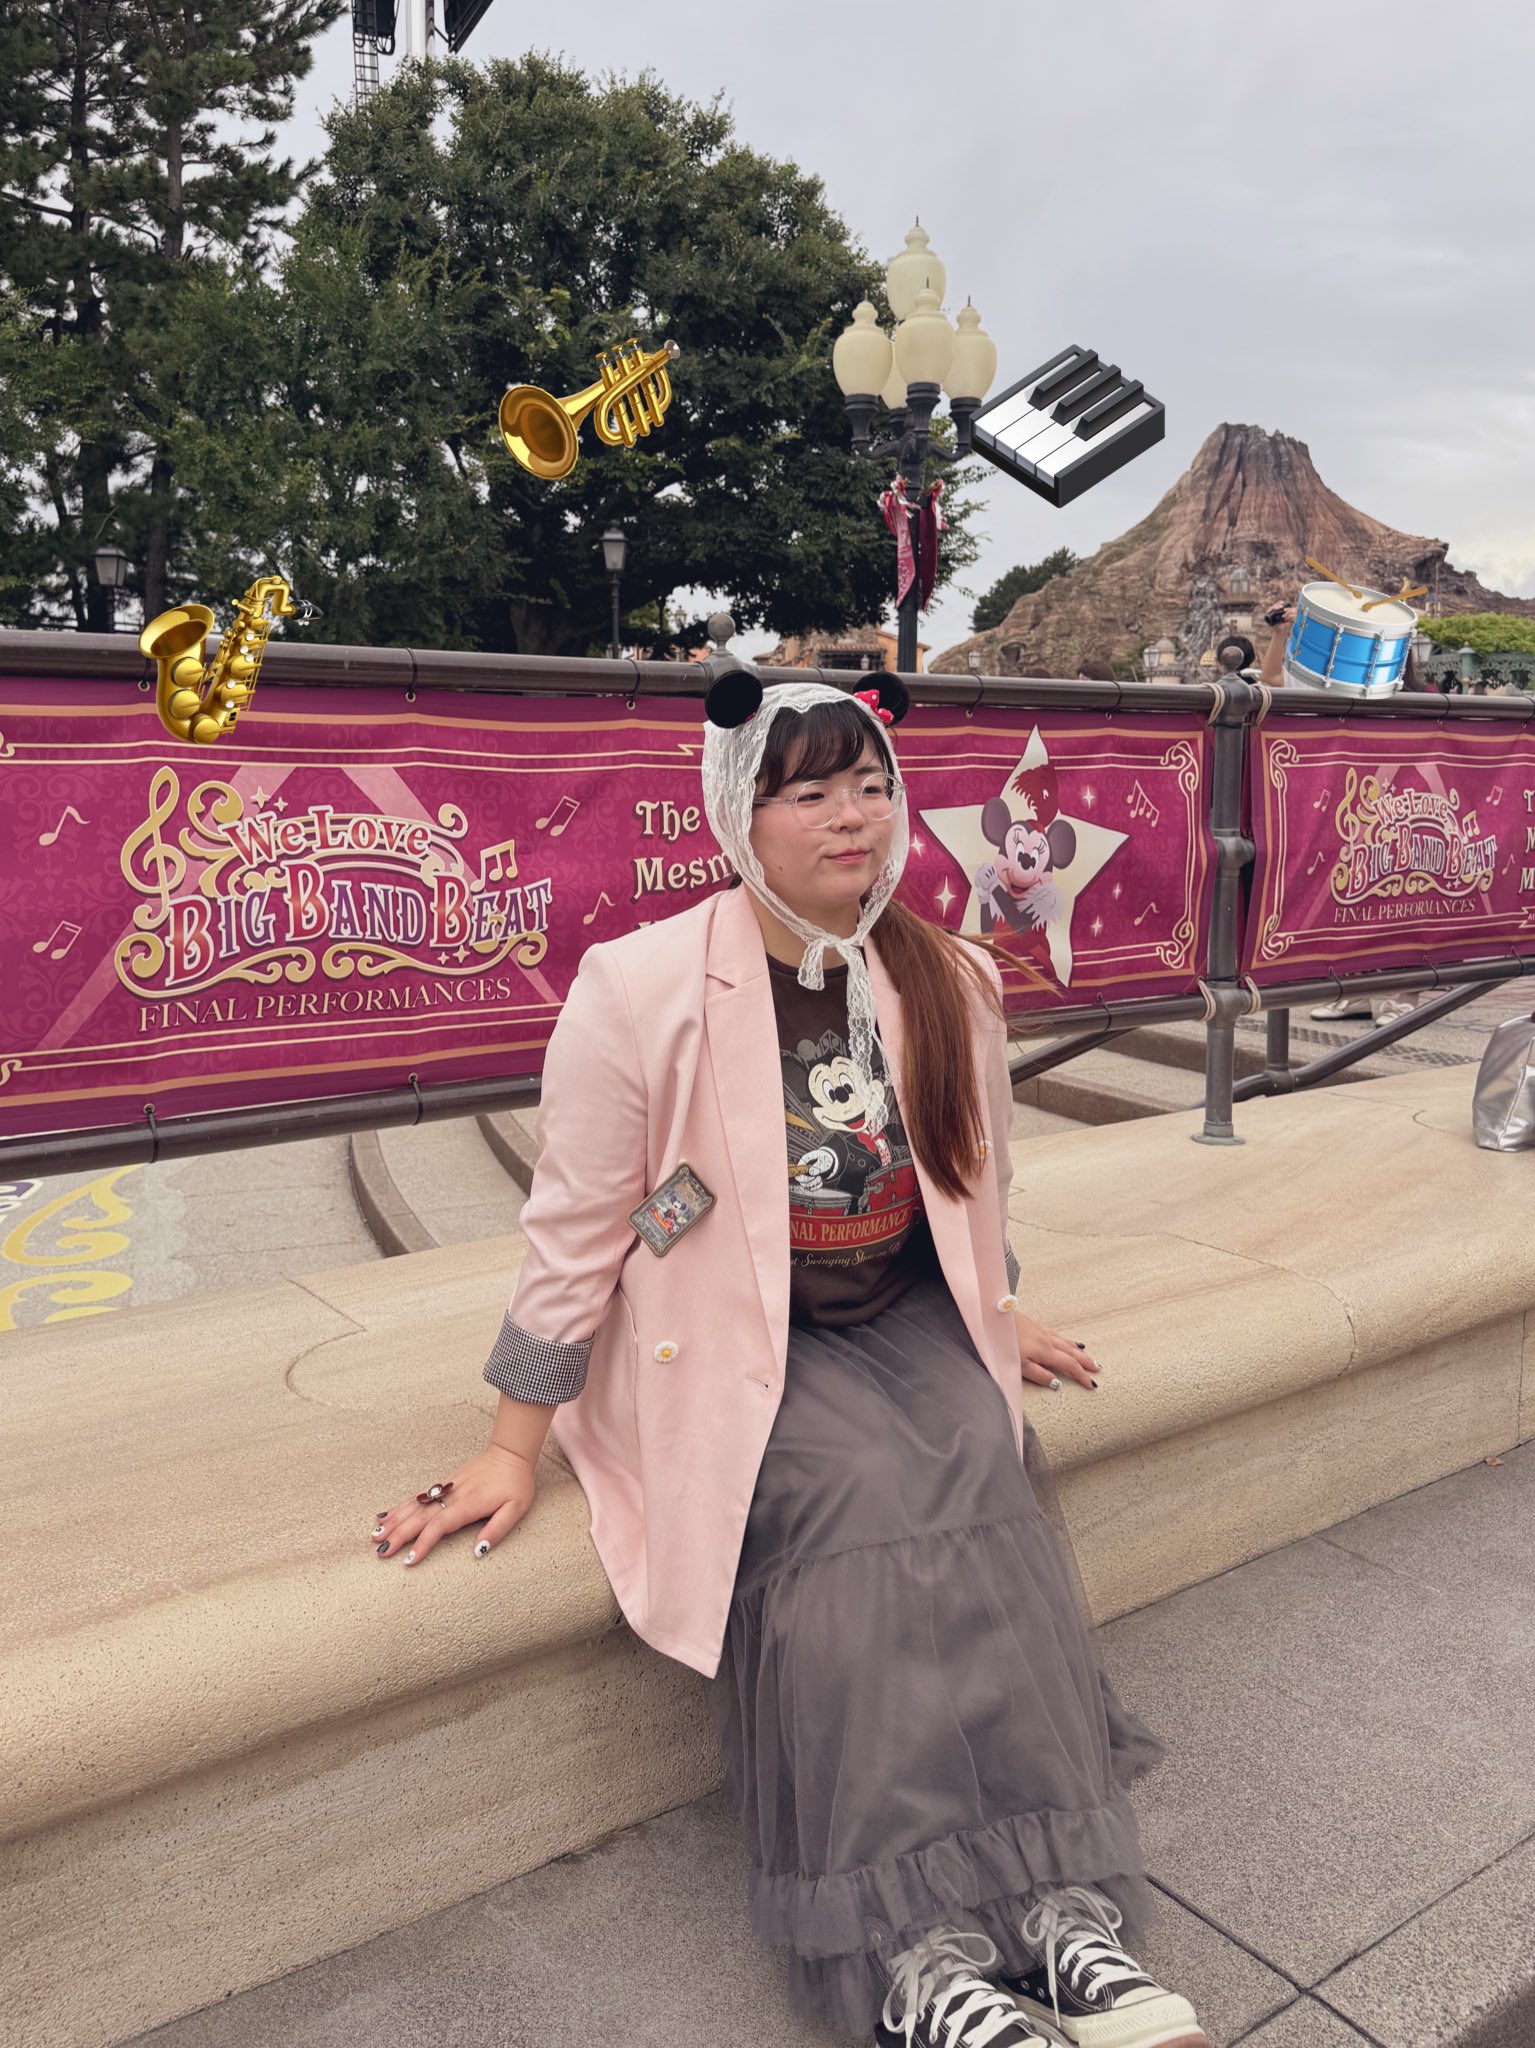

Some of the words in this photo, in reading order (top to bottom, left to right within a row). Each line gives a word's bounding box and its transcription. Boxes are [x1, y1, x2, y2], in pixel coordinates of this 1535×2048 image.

[635, 800, 700, 841] The
[1372, 793, 1404, 826] We
[1403, 788, 1448, 820] Love
[218, 811, 303, 867] We
[308, 804, 432, 856] Love
[1346, 840, 1393, 898] BIG
[1395, 822, 1445, 874] BAND
[1443, 832, 1497, 879] BEAT
[165, 887, 275, 986] BIG
[281, 859, 427, 943] BAND
[429, 872, 552, 947] BEAT
[1334, 904, 1375, 923] FINAL
[1378, 899, 1475, 920] PERFORMANCES
[139, 998, 248, 1032] FINAL
[256, 977, 511, 1019] PERFORMANCES
[801, 1253, 850, 1267] Swinging
